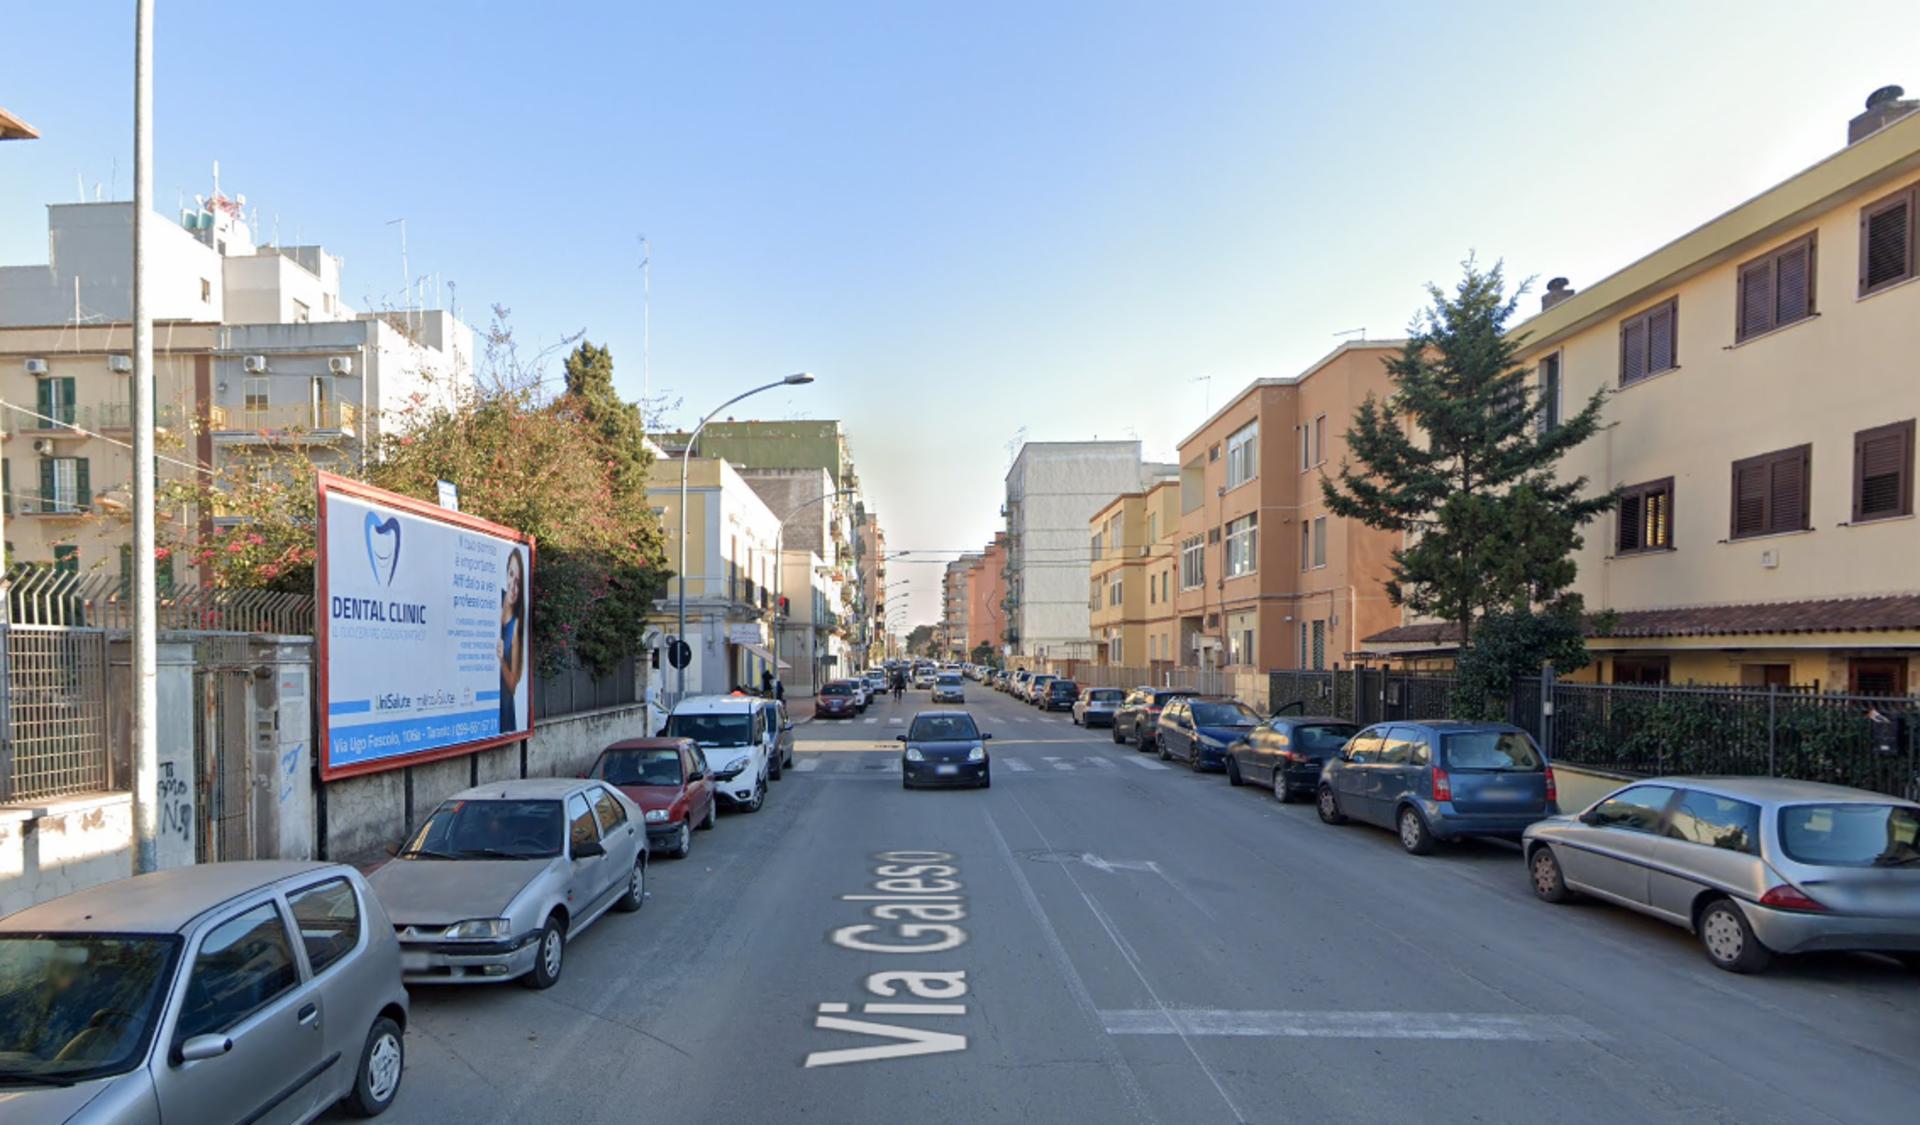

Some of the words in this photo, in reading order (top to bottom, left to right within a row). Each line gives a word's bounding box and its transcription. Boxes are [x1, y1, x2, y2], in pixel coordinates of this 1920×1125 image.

[332, 596, 386, 622] DENTAL
[389, 602, 427, 625] CLINIC
[333, 736, 349, 753] Via
[349, 736, 367, 755] Ugo
